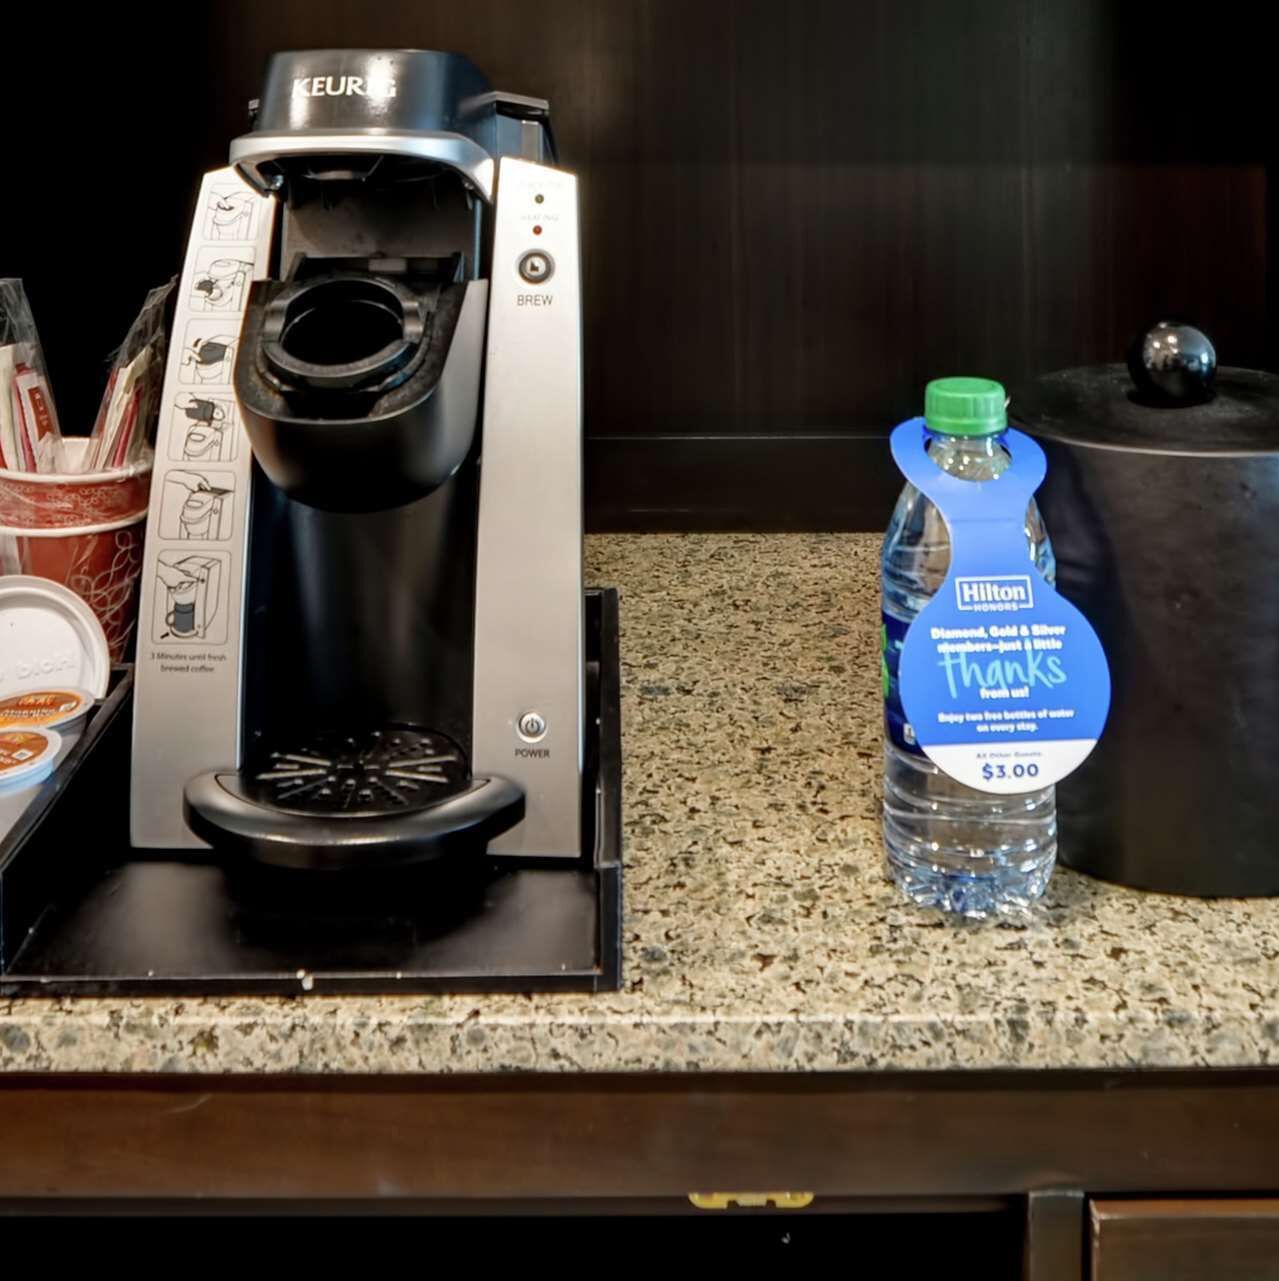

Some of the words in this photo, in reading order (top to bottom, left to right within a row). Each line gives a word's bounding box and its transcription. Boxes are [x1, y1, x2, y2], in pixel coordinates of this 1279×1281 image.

[291, 76, 397, 98] KEURG
[516, 294, 554, 307] BREW
[962, 583, 1026, 603] Hilton
[974, 603, 1019, 612] HONORS
[930, 627, 988, 641] Diamond,
[989, 625, 1018, 638] Gold
[1020, 625, 1029, 636] &
[1031, 624, 1066, 636] Silver
[1033, 638, 1063, 650] little
[980, 687, 1010, 700] from
[1012, 686, 1030, 699] us!
[967, 713, 983, 722] two
[984, 711, 1002, 721] free
[1038, 710, 1048, 719] of
[990, 723, 1016, 733] every
[514, 748, 550, 758] POWER
[982, 763, 1039, 781] $3.00
